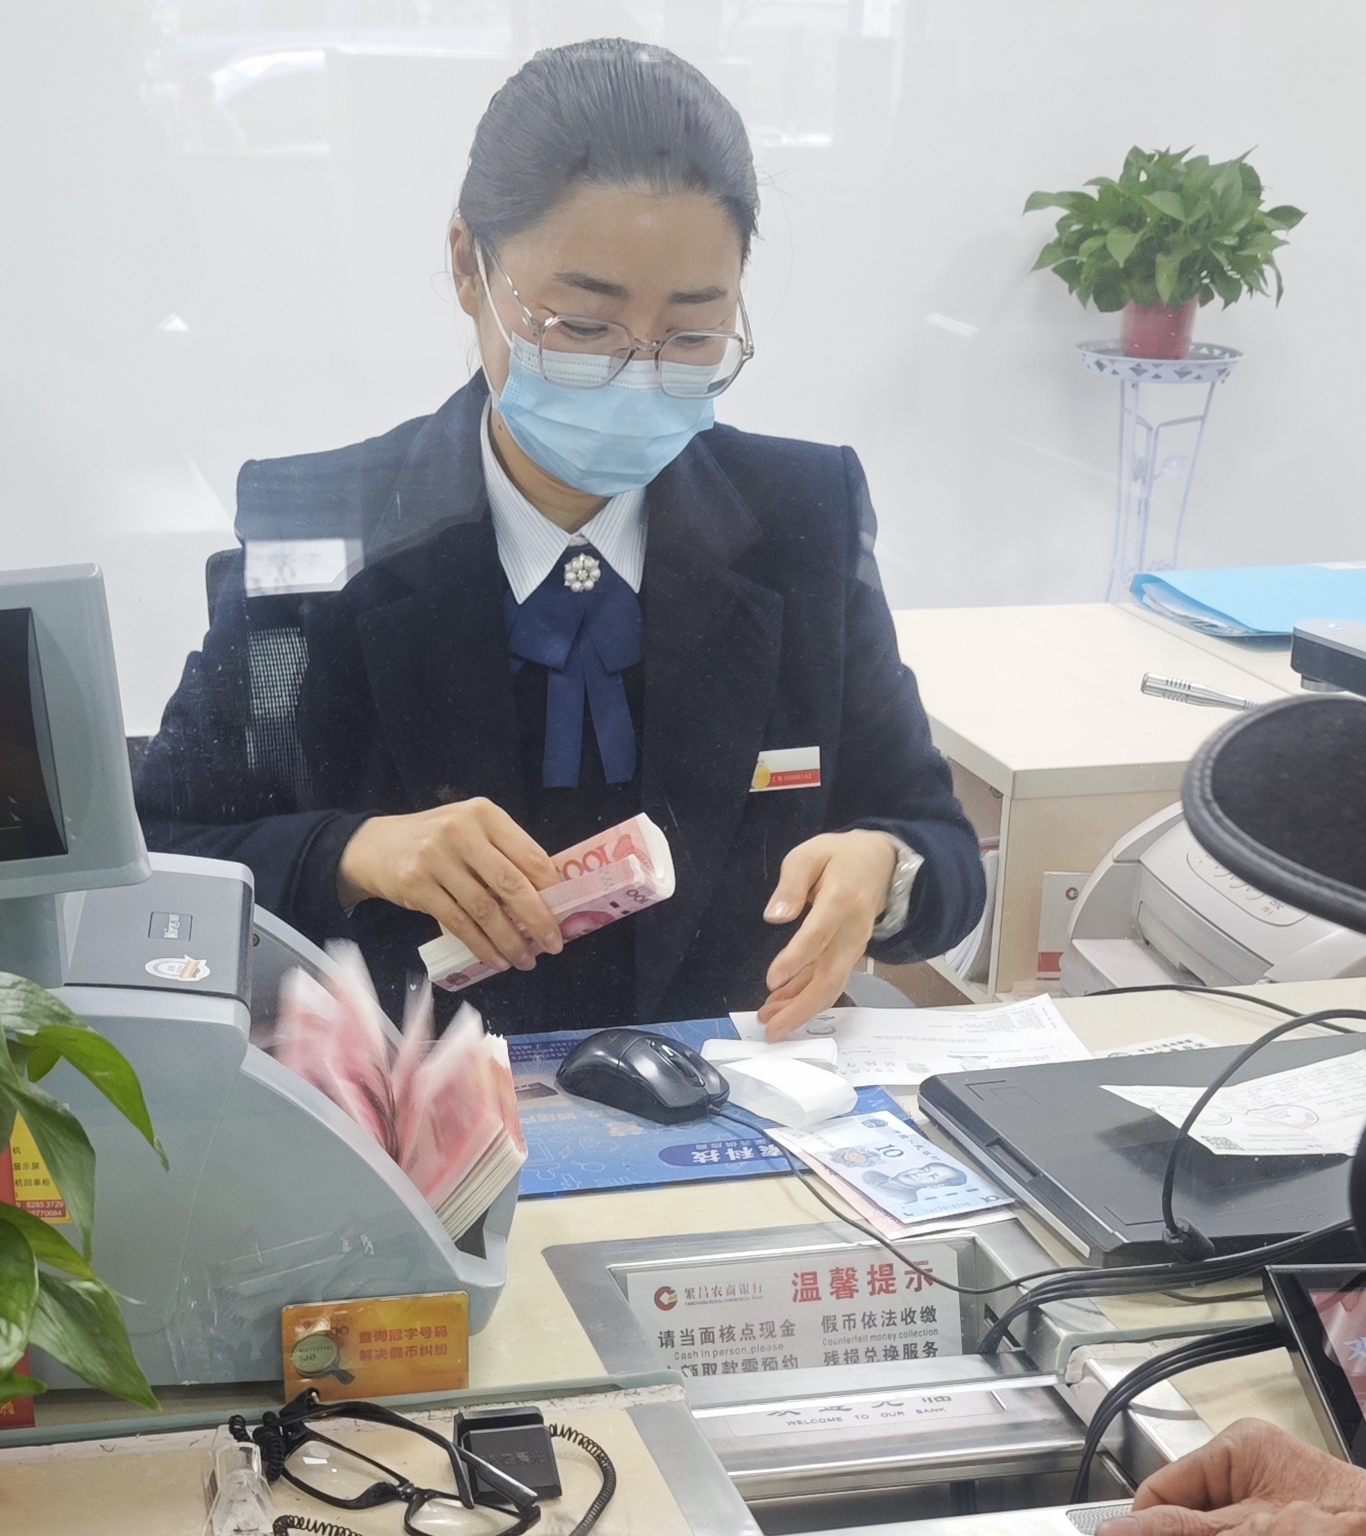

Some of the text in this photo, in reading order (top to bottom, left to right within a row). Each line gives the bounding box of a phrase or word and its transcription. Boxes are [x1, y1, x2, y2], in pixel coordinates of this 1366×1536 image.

[684, 1281, 764, 1300] 繁昌农商银行
[791, 1260, 935, 1304] 温馨提示
[822, 1305, 938, 1334] 假币依法收缴
[359, 1325, 448, 1344] 查询冠字号码
[657, 1319, 796, 1349] 请当面核点现金
[823, 1328, 939, 1346] Counterfeit money collection
[359, 1344, 448, 1363] 解决假币纠纷
[674, 1350, 699, 1361] Cash
[701, 1350, 711, 1358] in
[786, 1416, 844, 1426] WELCOME
[854, 1413, 869, 1421] TO
[915, 1406, 948, 1415] BANK
